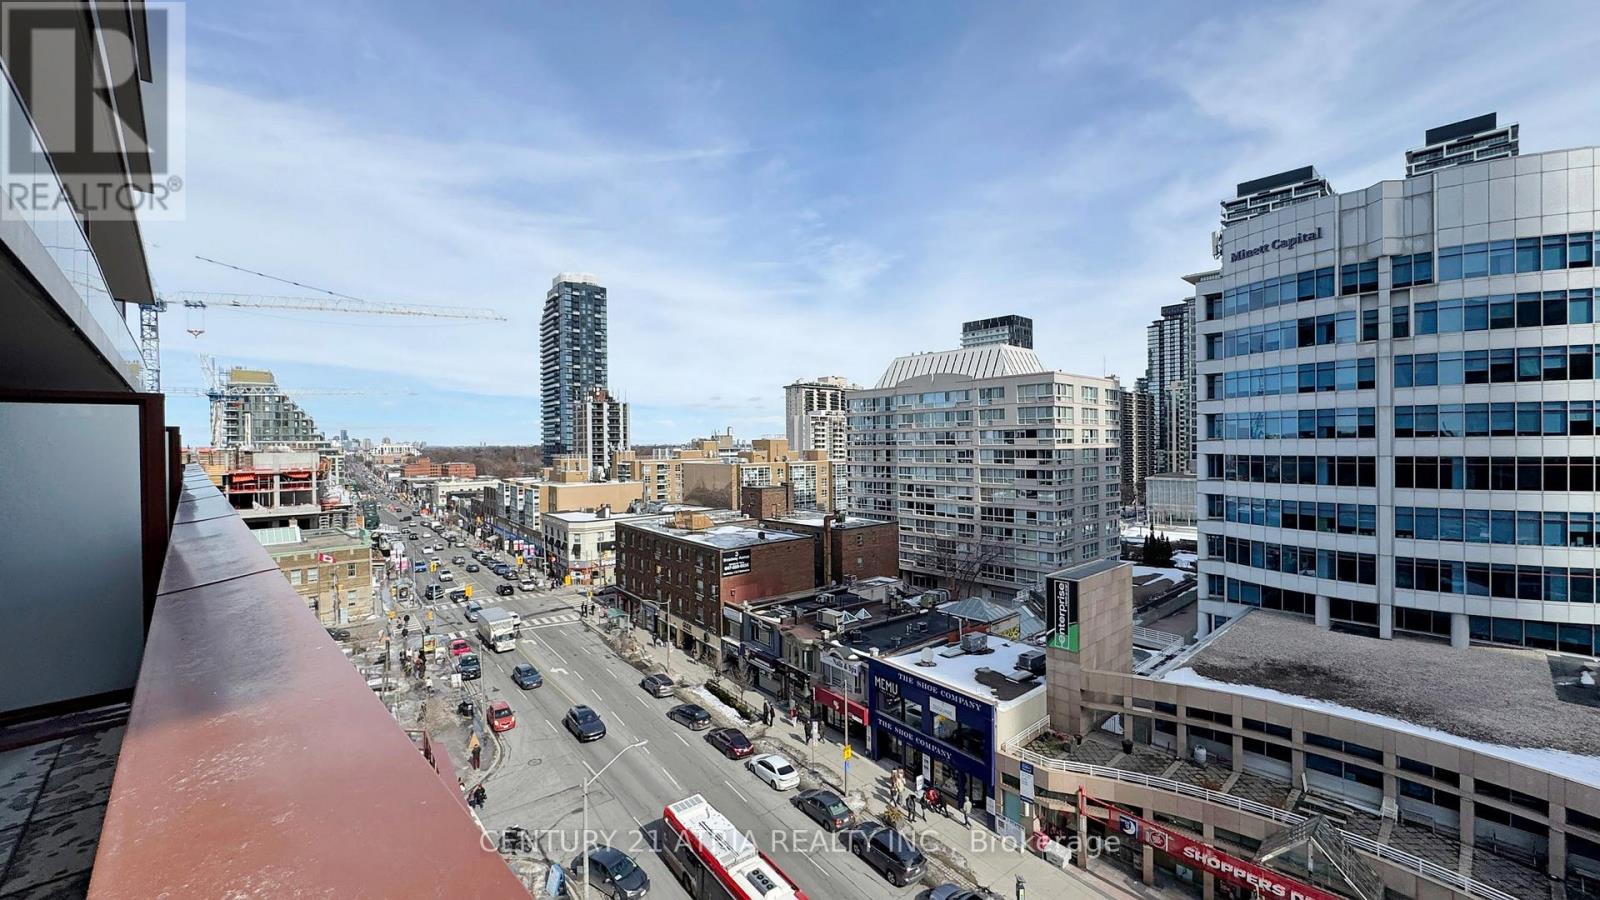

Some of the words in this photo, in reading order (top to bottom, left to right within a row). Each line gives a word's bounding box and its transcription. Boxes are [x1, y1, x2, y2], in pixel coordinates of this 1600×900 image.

[1231, 244, 1270, 263] Minett
[1271, 227, 1322, 250] Capital
[1057, 582, 1067, 645] enterprise
[874, 675, 899, 695] MEMU
[898, 672, 914, 685] THE
[917, 679, 938, 695] SHOE
[940, 690, 982, 712] COMPANY
[878, 718, 892, 730] THE
[894, 727, 914, 741] SHOE
[915, 736, 953, 760] COMPANY
[1183, 846, 1286, 897] SHOPPERS
